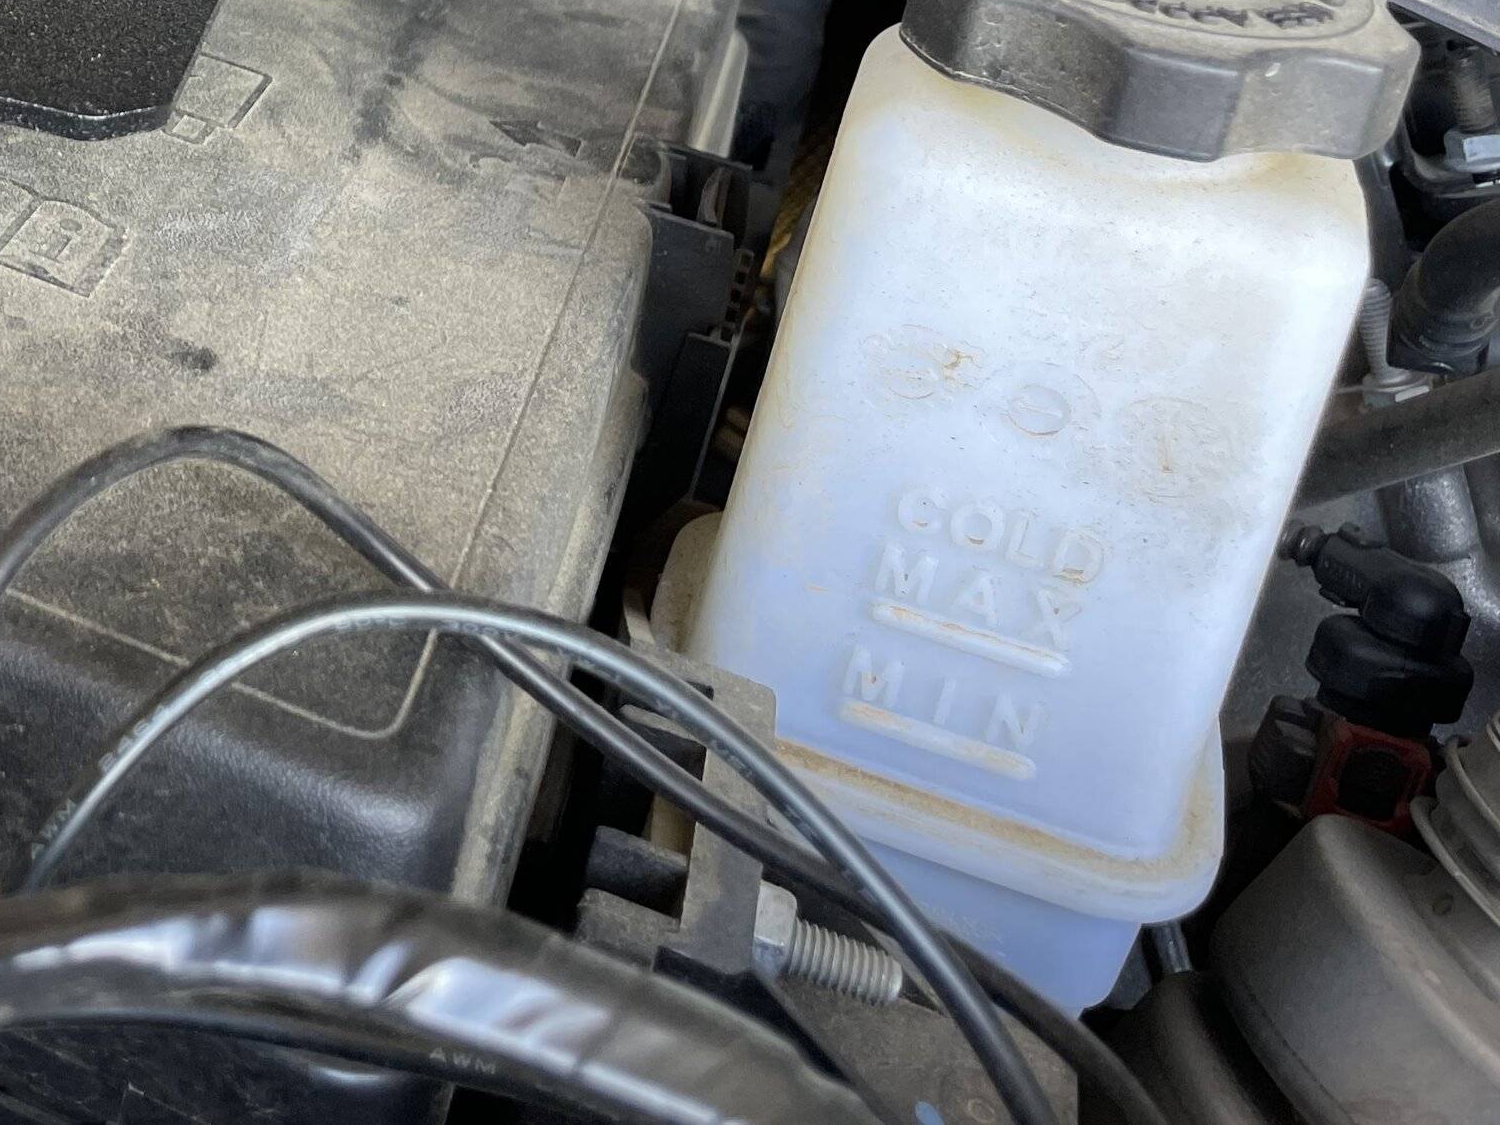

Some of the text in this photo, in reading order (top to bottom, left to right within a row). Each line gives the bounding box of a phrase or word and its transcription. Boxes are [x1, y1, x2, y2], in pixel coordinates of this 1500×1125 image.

[897, 485, 1105, 586] COLD
[874, 540, 1083, 652] MAX
[842, 643, 1050, 749] MIN
[428, 1046, 497, 1075] AWM
